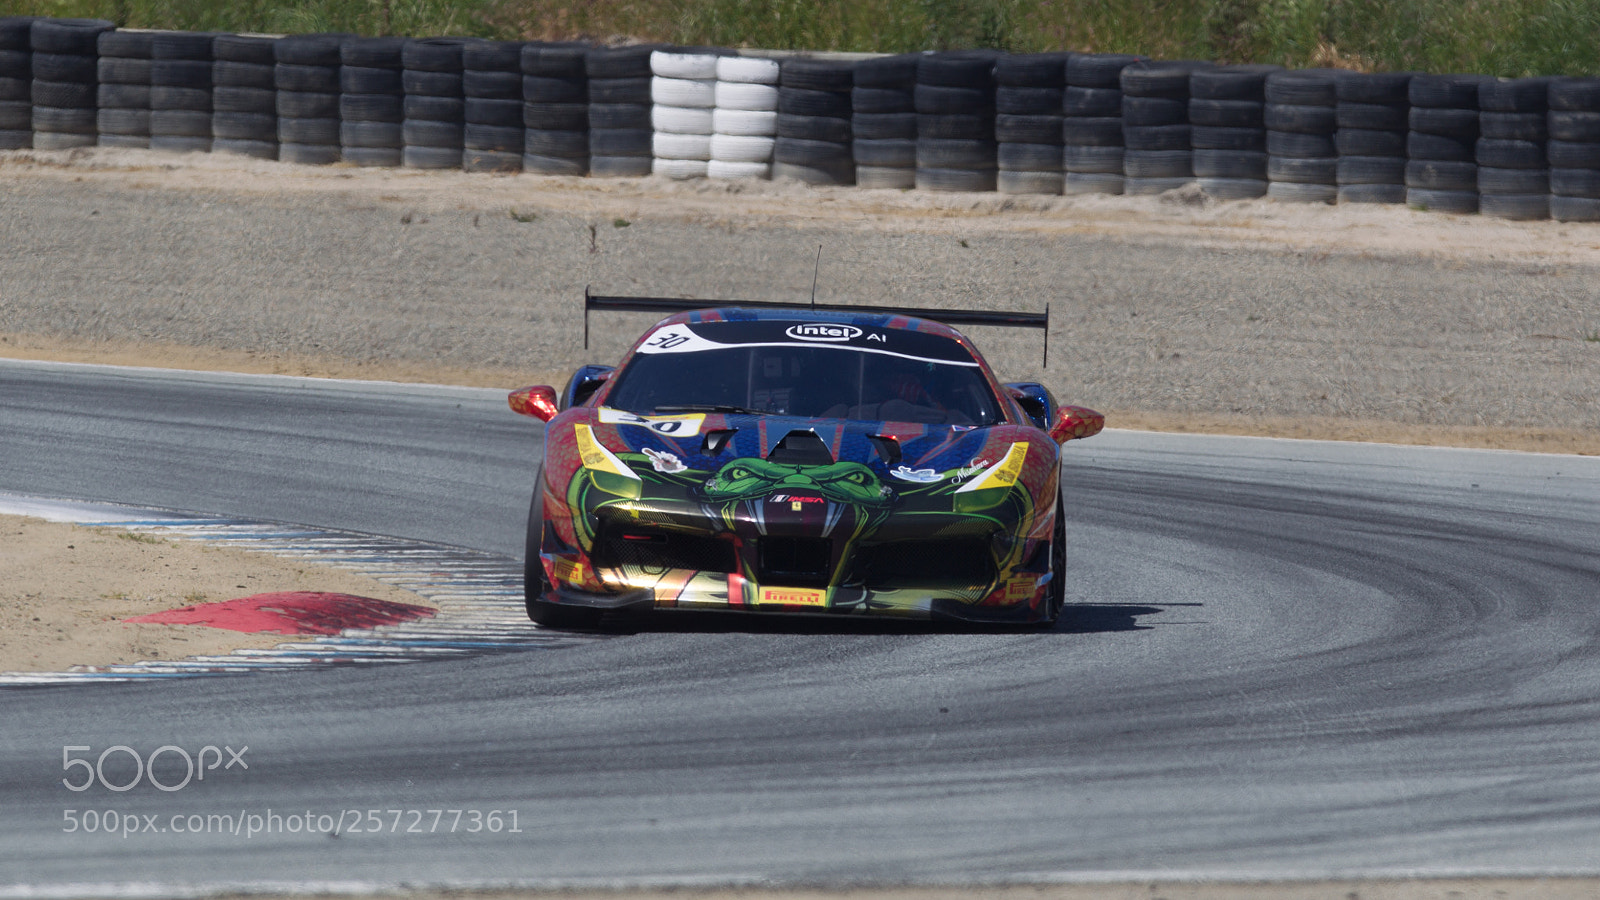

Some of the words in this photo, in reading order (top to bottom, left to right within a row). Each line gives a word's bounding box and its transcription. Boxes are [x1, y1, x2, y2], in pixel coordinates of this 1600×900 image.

[797, 325, 849, 338] intel
[867, 333, 887, 342] AI
[646, 333, 690, 349] 30
[787, 496, 825, 504] IMSA
[765, 590, 820, 603] PIRELLI
